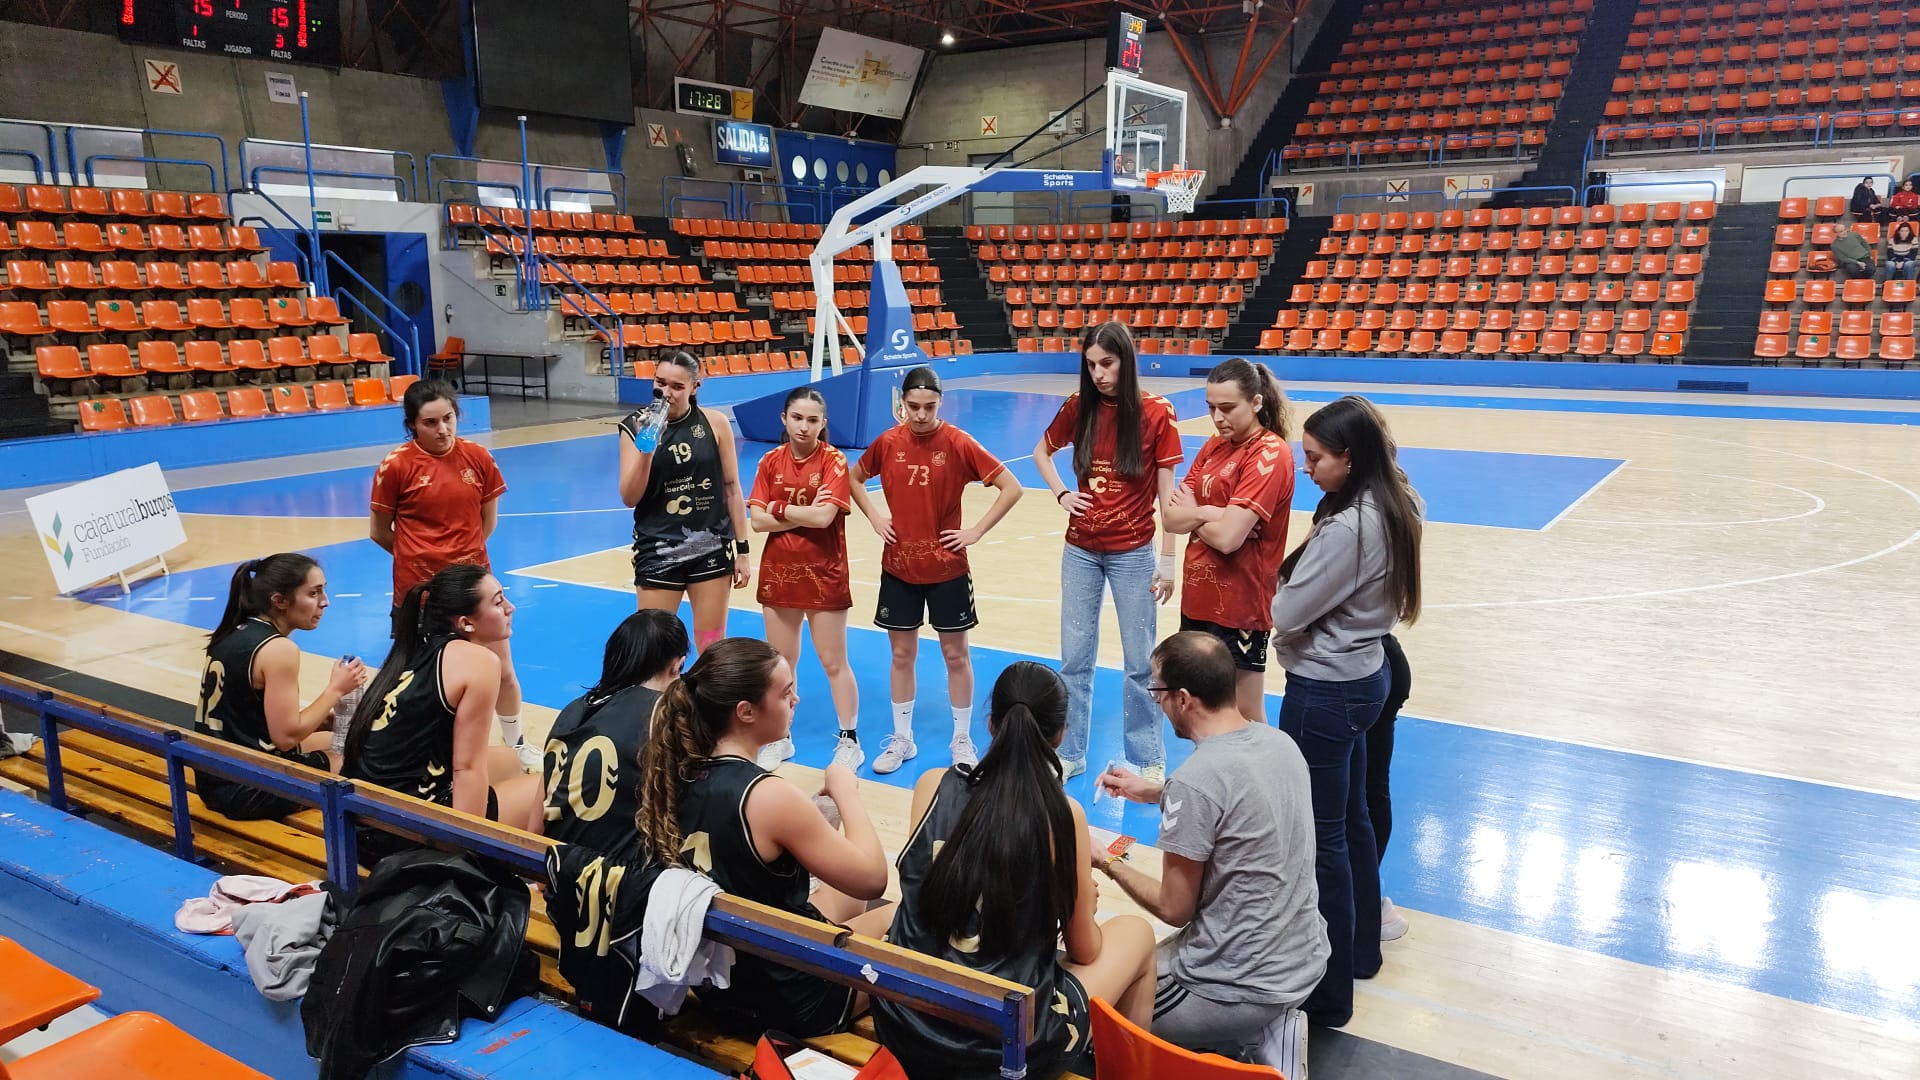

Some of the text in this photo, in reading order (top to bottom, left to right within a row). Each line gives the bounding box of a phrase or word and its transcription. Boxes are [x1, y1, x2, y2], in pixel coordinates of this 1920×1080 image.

[193, 0, 214, 17] 15
[225, 9, 248, 20] PERIODO
[272, 7, 289, 28] 15
[193, 24, 198, 37] 1
[182, 38, 207, 49] FALTAS
[223, 44, 252, 55] JUGADOR
[275, 33, 284, 48] 3
[270, 49, 292, 60] FALTAS
[1122, 38, 1142, 68] 24
[689, 90, 722, 110] 17:28
[717, 126, 758, 154] SALIDA
[1889, 158, 1901, 173] 7
[1043, 180, 1075, 188] Sports
[668, 442, 693, 465] 19
[907, 464, 930, 486] 73
[784, 487, 808, 506] 76
[73, 493, 174, 543] cajaruralburgos
[81, 536, 132, 563] Fundación
[195, 655, 225, 731] 12
[544, 735, 619, 822] 20
